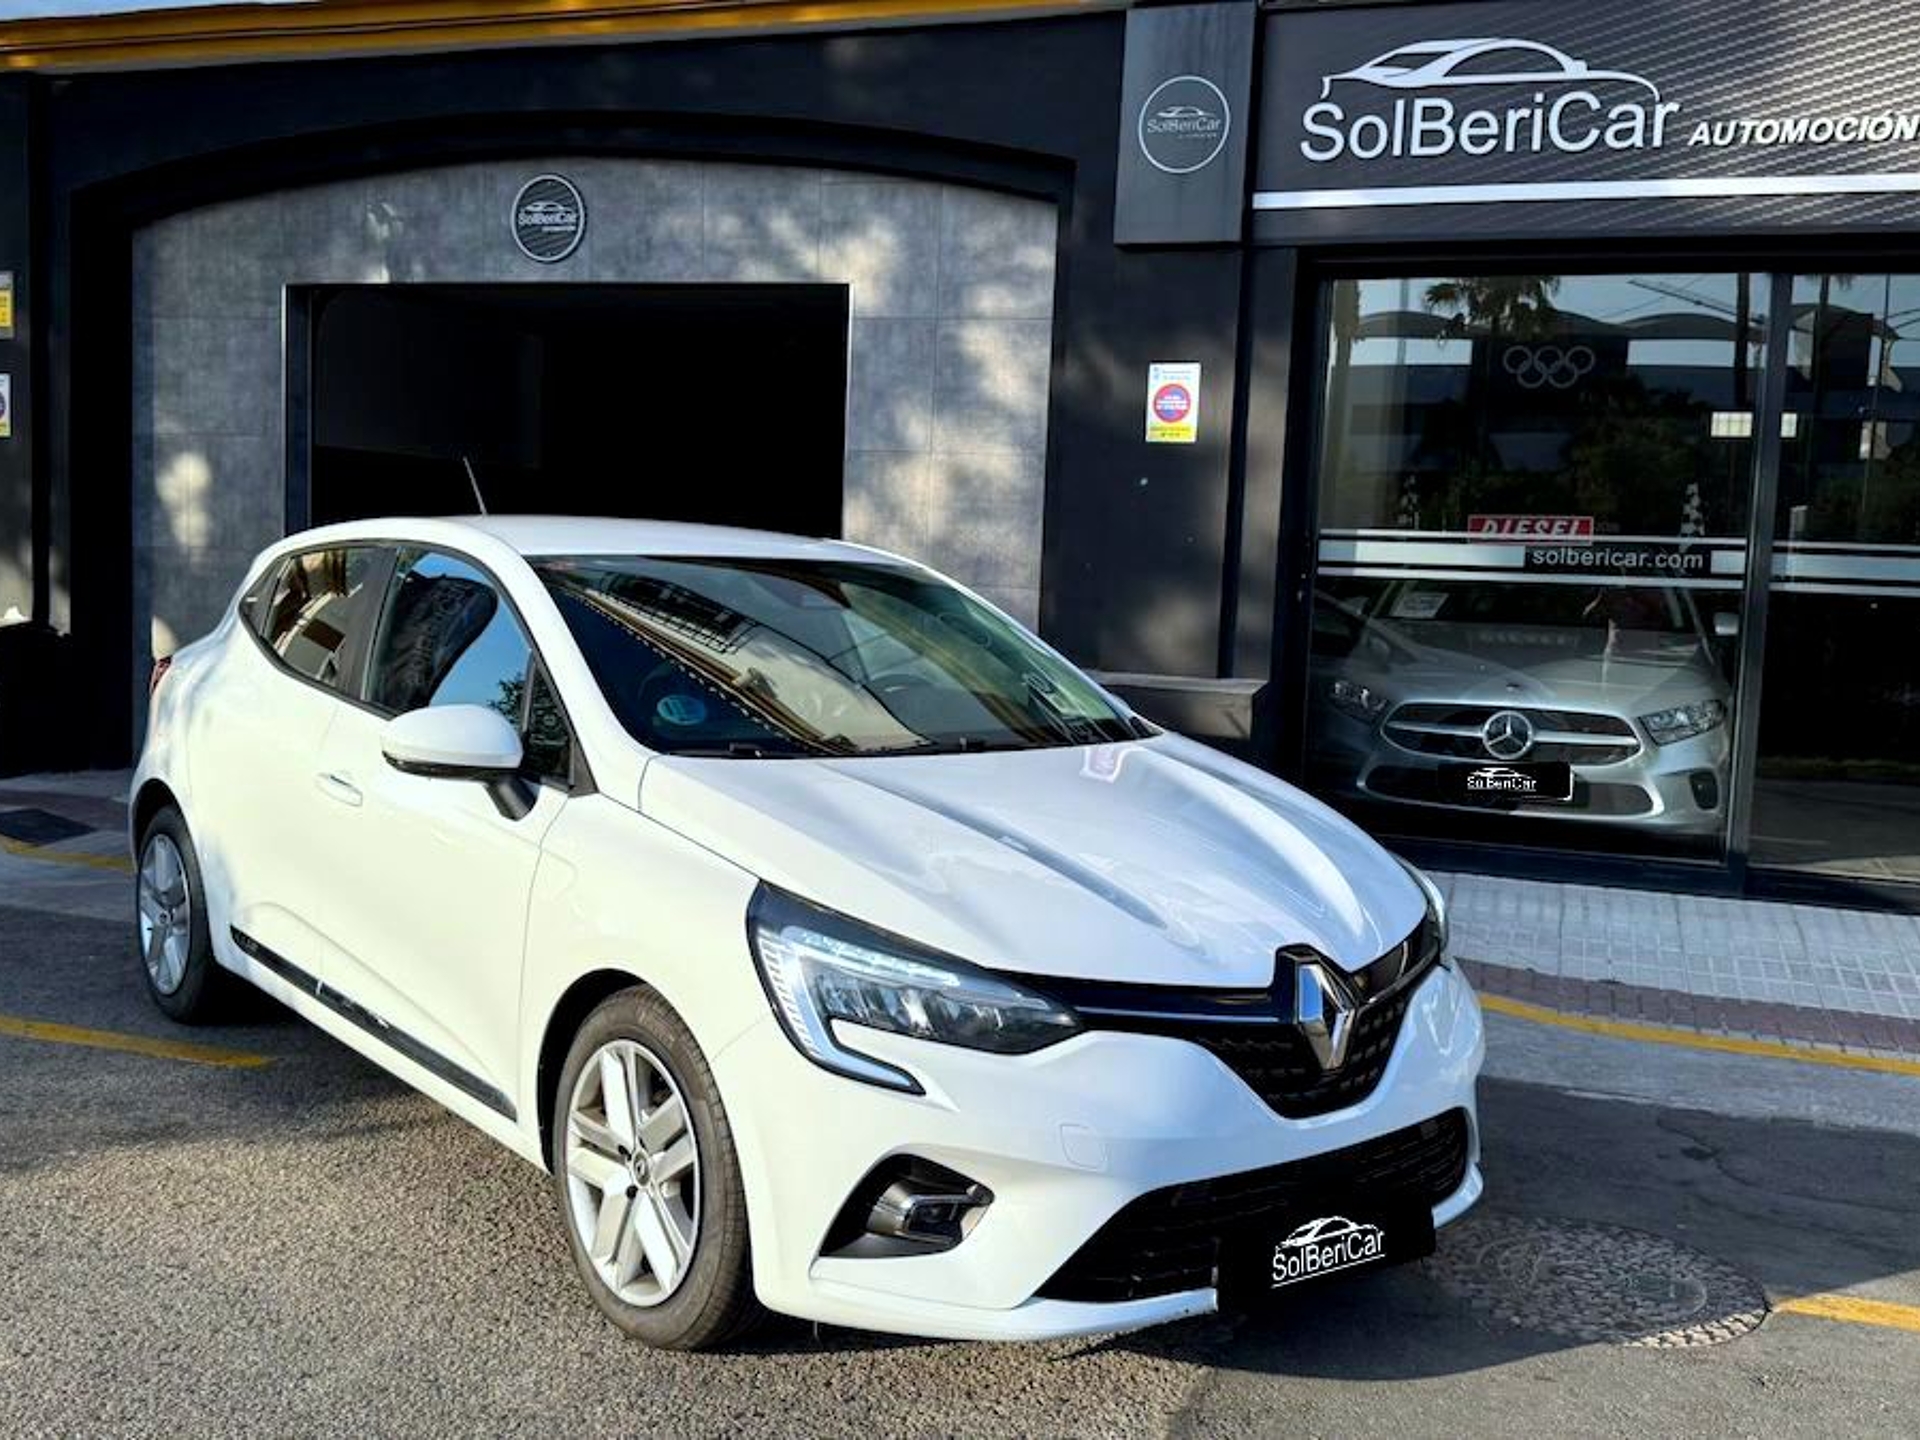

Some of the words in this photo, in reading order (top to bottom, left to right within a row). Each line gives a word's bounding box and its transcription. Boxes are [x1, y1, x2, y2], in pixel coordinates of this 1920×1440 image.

[1300, 91, 1680, 162] SolBeriCar
[1688, 110, 1919, 147] AUTOMOCIÓN
[1532, 545, 1704, 568] solbericar.com
